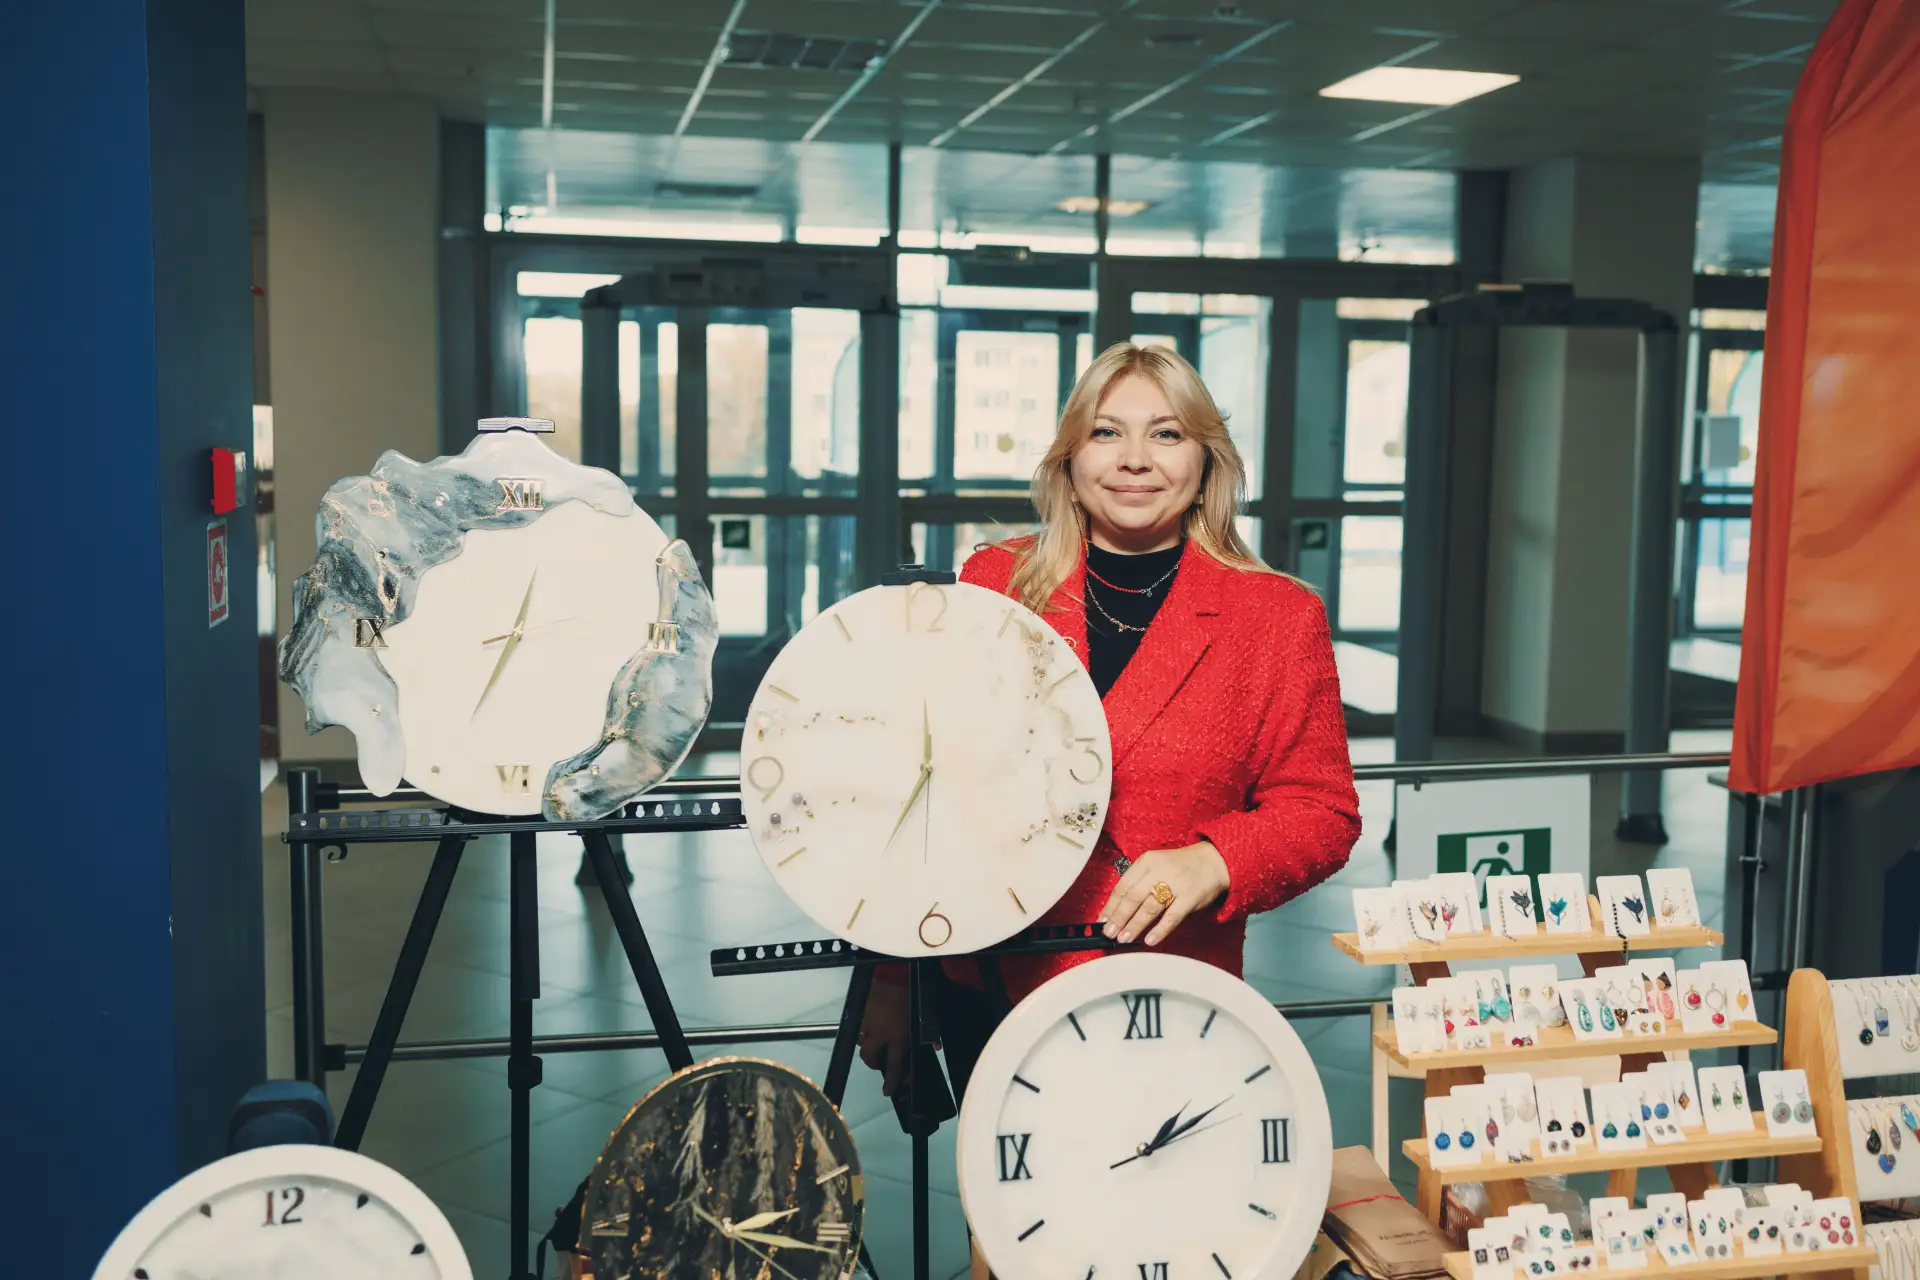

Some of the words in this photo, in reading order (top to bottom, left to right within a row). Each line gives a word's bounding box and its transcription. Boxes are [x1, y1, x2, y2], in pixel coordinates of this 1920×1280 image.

[496, 477, 545, 511] XII
[904, 581, 949, 633] 12
[354, 617, 390, 649] IX
[647, 622, 680, 654] III
[494, 763, 532, 794] VI
[747, 755, 784, 804] 9
[1069, 736, 1104, 784] 3
[918, 900, 952, 948] 6
[1120, 993, 1163, 1040] XII
[996, 1133, 1033, 1182] IX
[1260, 1118, 1291, 1164] III
[261, 1186, 305, 1227] 12
